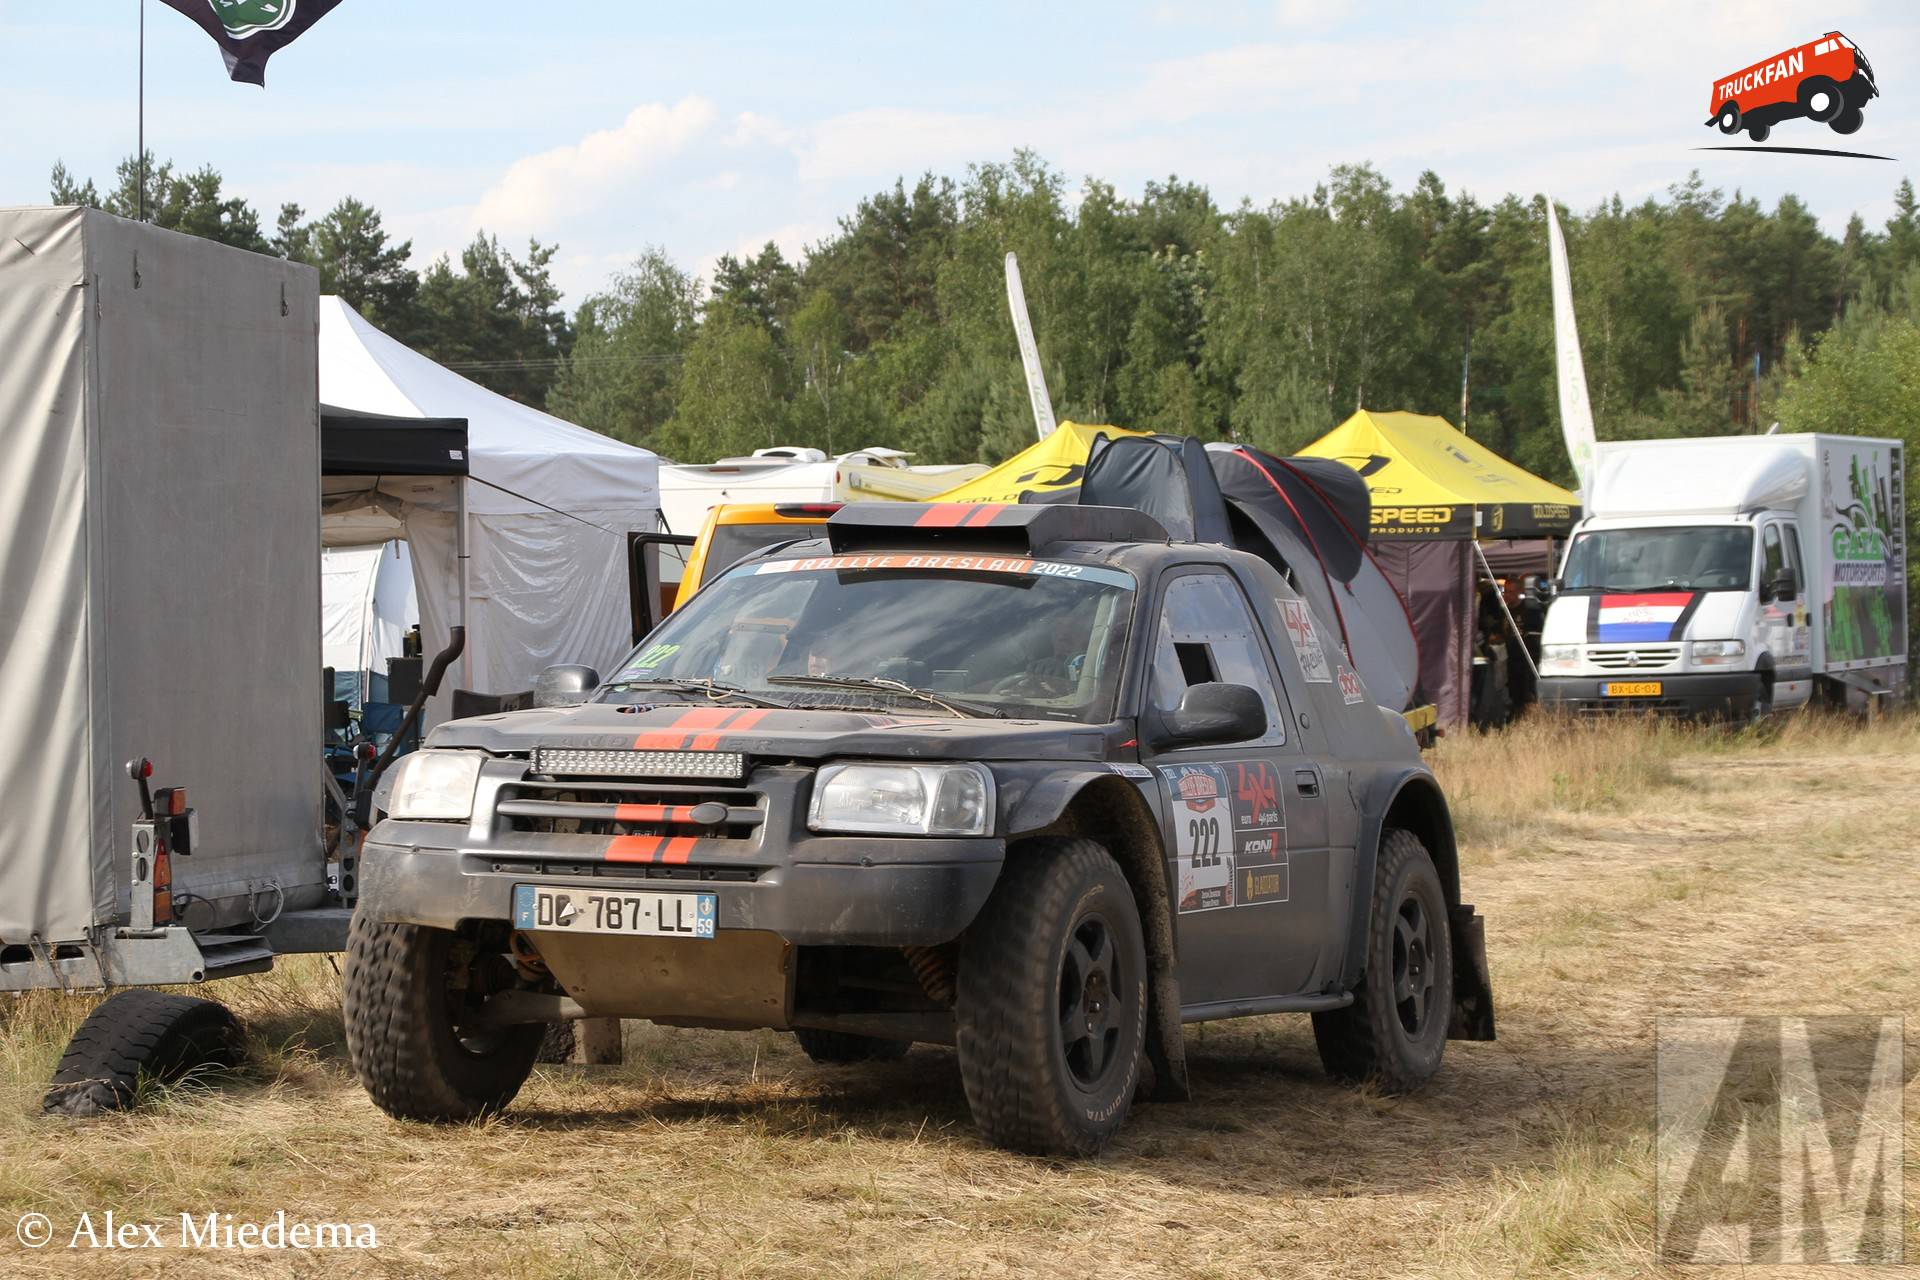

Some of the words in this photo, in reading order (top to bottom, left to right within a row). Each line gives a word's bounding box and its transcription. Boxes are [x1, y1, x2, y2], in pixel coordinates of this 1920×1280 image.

[1369, 526, 1441, 534] PRODUCTS
[800, 555, 900, 571] RALLYE
[906, 555, 1030, 573] BRESLAU
[1033, 562, 1084, 578] 2022
[1189, 816, 1221, 869] 222
[1244, 839, 1273, 853] KONI
[697, 918, 714, 935] 59
